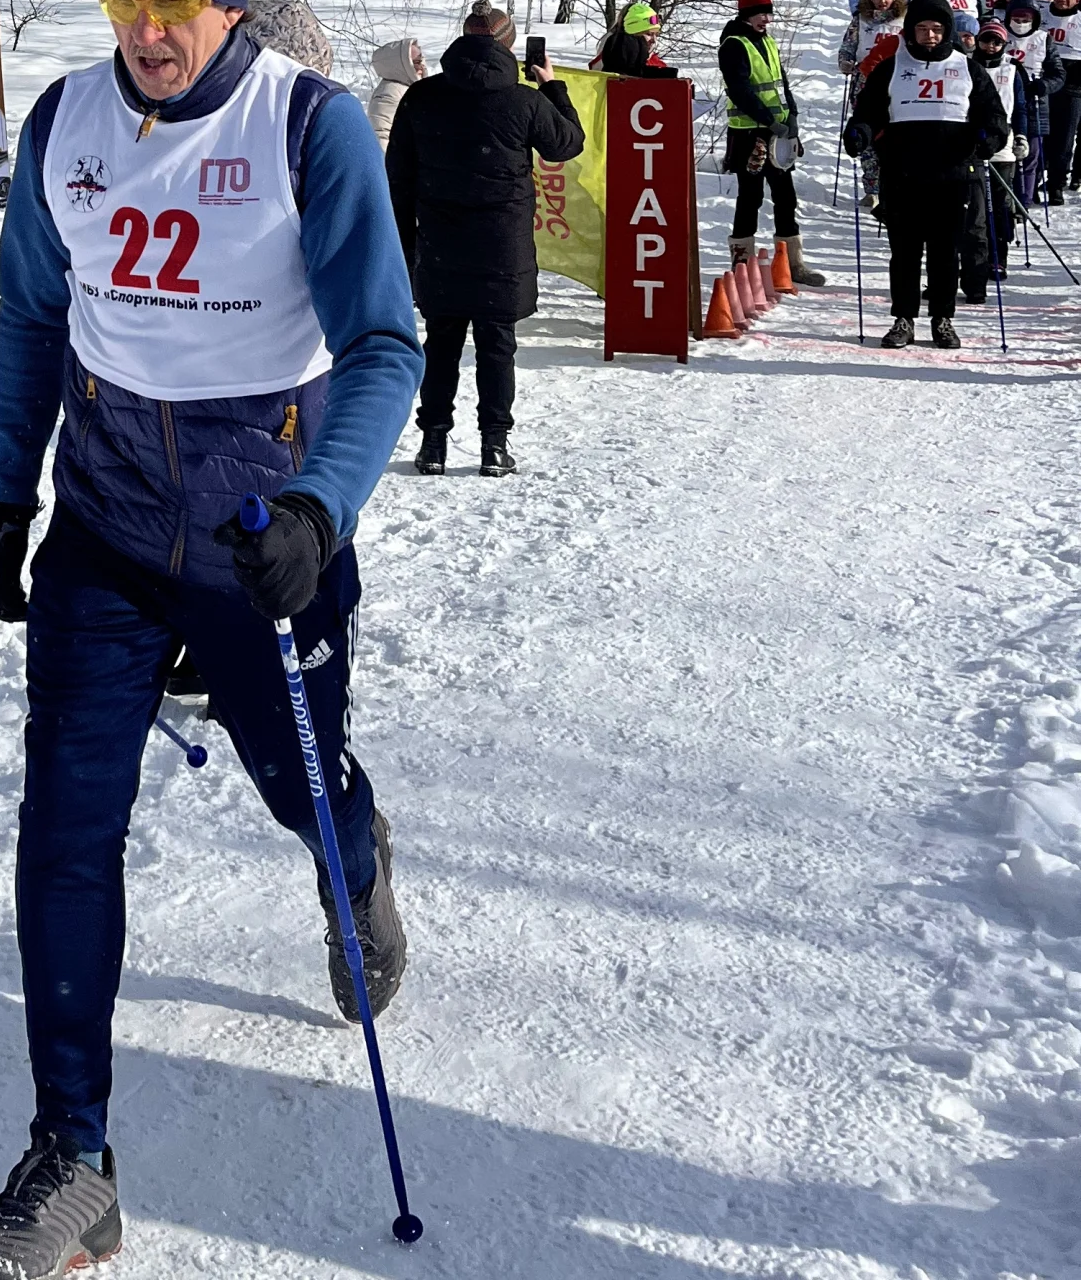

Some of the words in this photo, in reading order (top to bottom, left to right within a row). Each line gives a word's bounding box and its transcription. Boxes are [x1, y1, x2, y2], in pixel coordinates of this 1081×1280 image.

[918, 79, 944, 99] 21
[199, 157, 251, 193] ГТО
[629, 98, 668, 319] СТАРТ
[109, 206, 200, 294] 22
[103, 289, 199, 311] «Спортивный
[203, 299, 263, 314] город»
